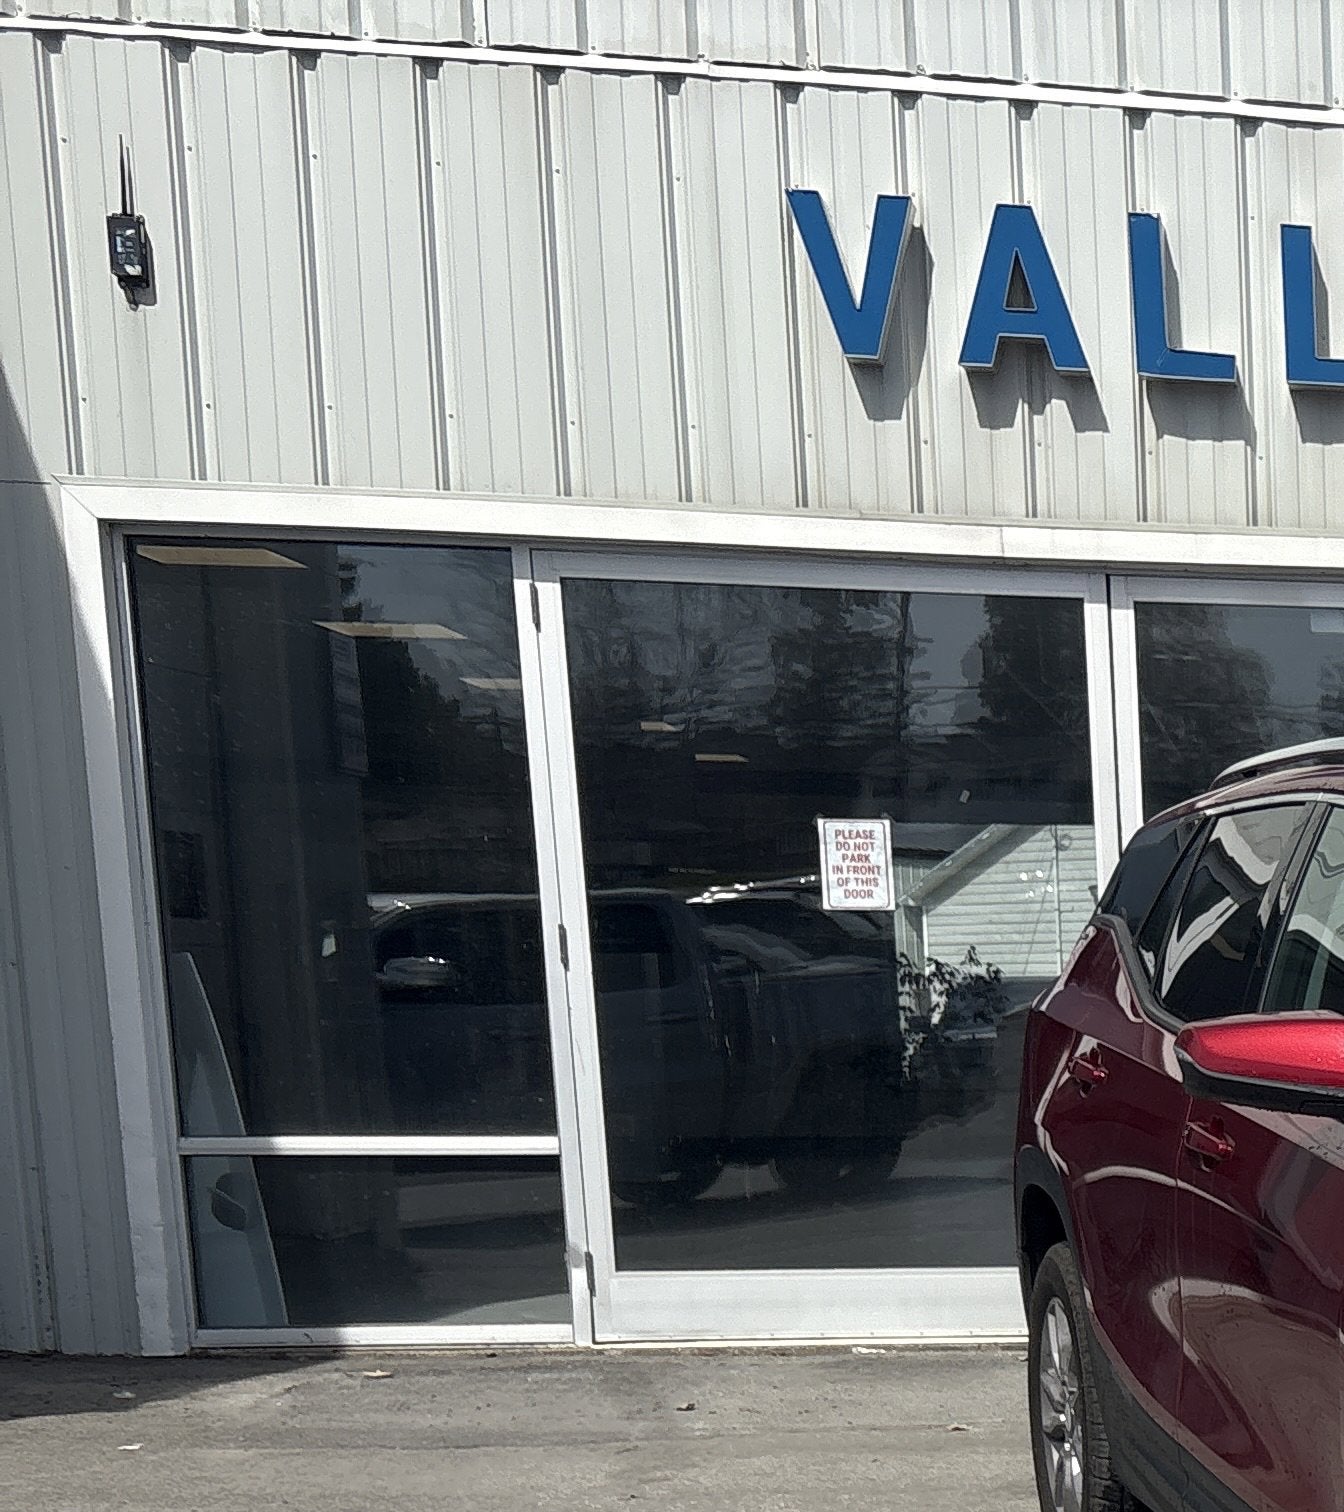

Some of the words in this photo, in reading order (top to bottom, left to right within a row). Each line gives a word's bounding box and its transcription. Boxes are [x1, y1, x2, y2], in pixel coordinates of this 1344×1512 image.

[835, 829, 875, 840] PLEASE
[836, 842, 850, 851] DO
[854, 842, 876, 851] NOT
[842, 853, 871, 863] PARK
[832, 866, 844, 875] IN
[846, 865, 881, 876] FRONT
[837, 878, 850, 887] OF
[854, 878, 879, 887] THIS
[844, 889, 874, 899] DOOR
